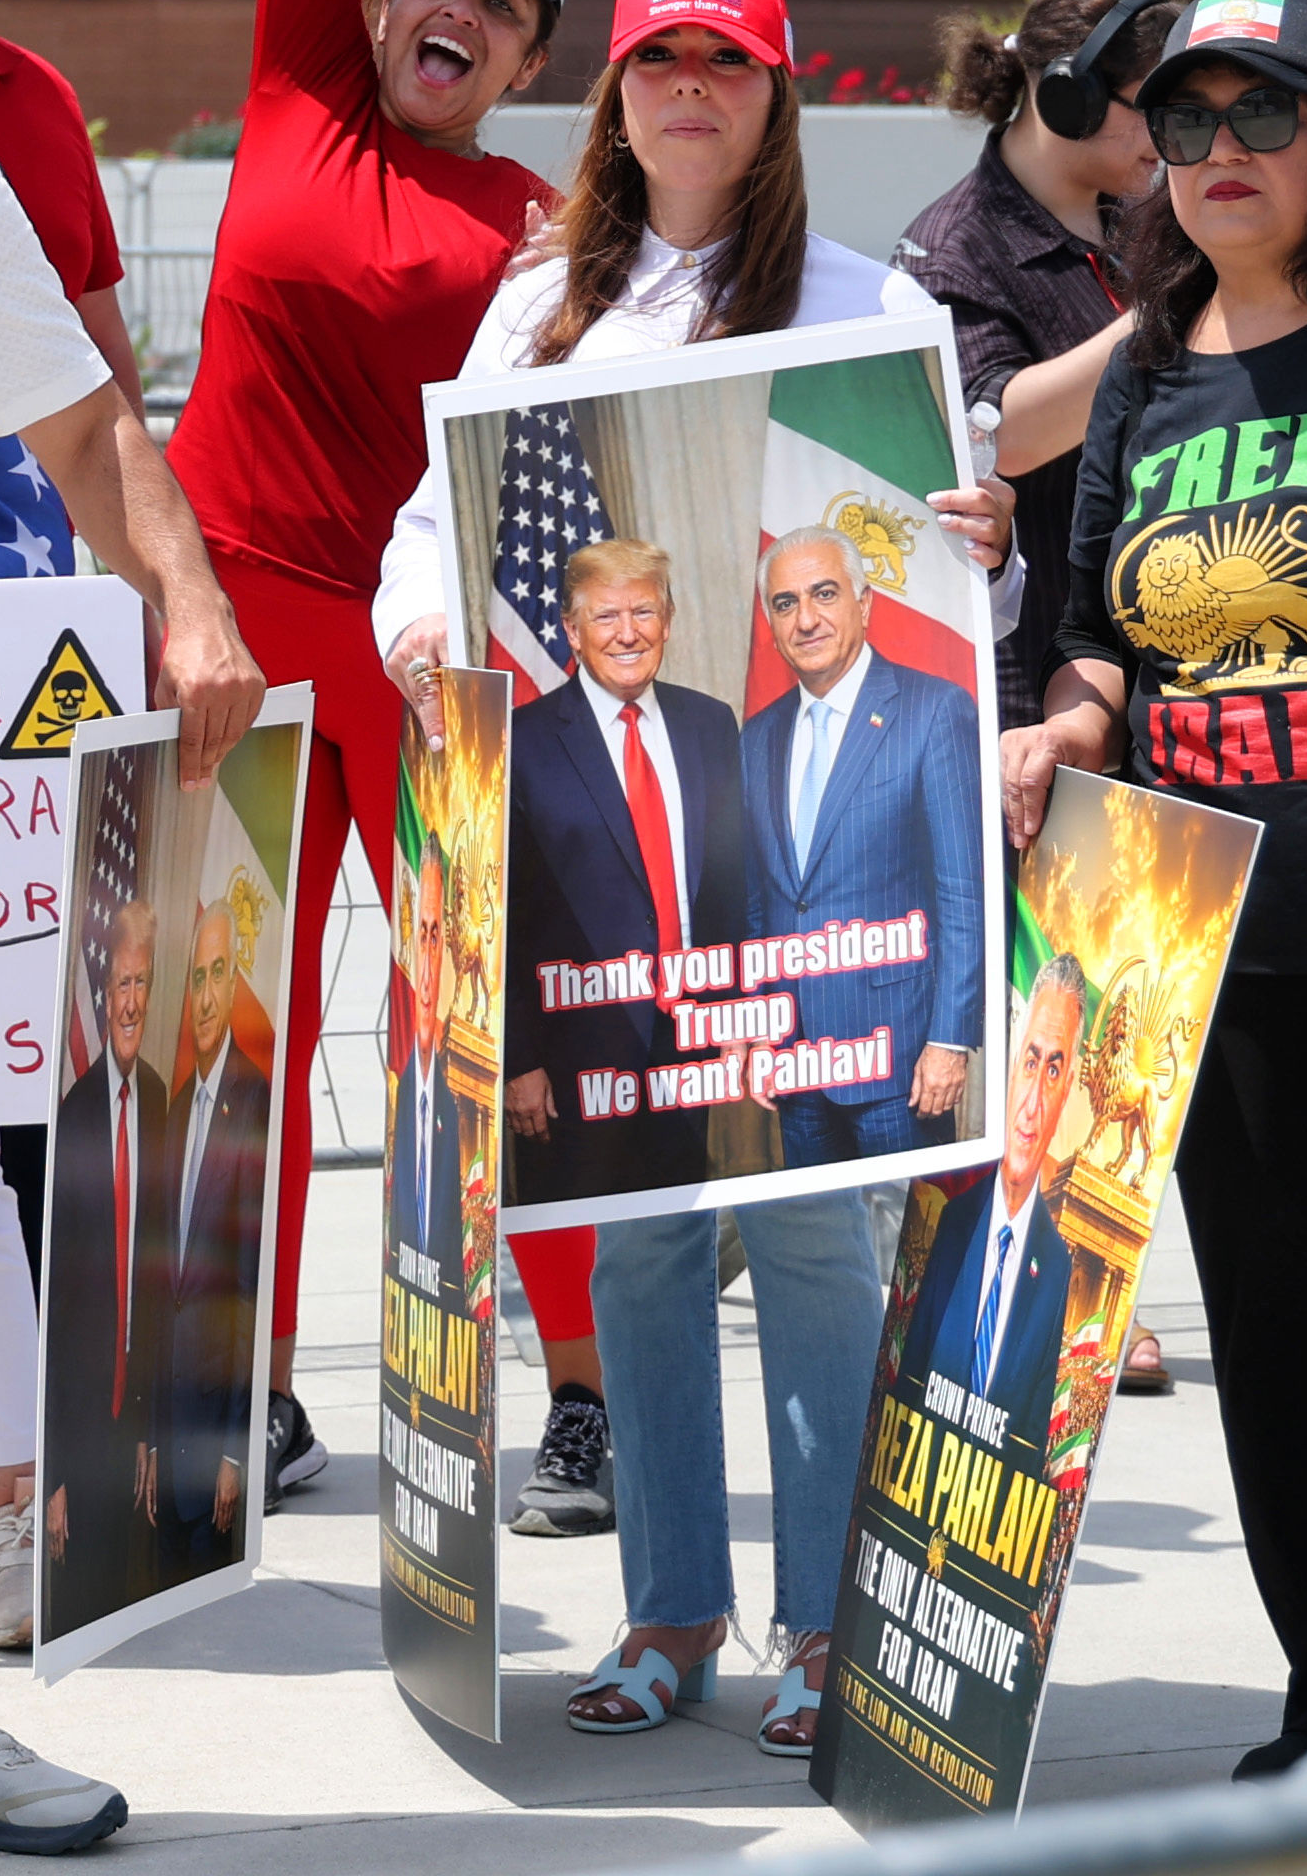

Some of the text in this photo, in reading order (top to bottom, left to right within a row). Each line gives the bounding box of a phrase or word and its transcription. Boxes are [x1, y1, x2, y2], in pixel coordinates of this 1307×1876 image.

[648, 0, 692, 17] Stronger
[720, 5, 743, 20] ever
[538, 912, 925, 1011] Thank you president
[672, 995, 794, 1050] Trump
[578, 1028, 890, 1119] We want Pahlavi
[407, 1292, 479, 1416] PAHLAVI
[924, 1370, 1010, 1450] CROWN PRINCE
[407, 1426, 476, 1517] ALTERNATIVE
[869, 1393, 1058, 1588] REZA PAHLAVI
[395, 1480, 411, 1538] FOR
[412, 1495, 439, 1557] IRAN
[429, 1577, 476, 1626] REVOLUTION
[854, 1528, 1025, 1693] THE ONLY ALTERNATIVE
[876, 1620, 959, 1722] FOR IRAN
[851, 1679, 868, 1715] THE
[867, 1696, 891, 1731] LION
[888, 1710, 910, 1749] AND
[908, 1725, 931, 1764] SUN
[928, 1740, 996, 1808] REVOLUTION
